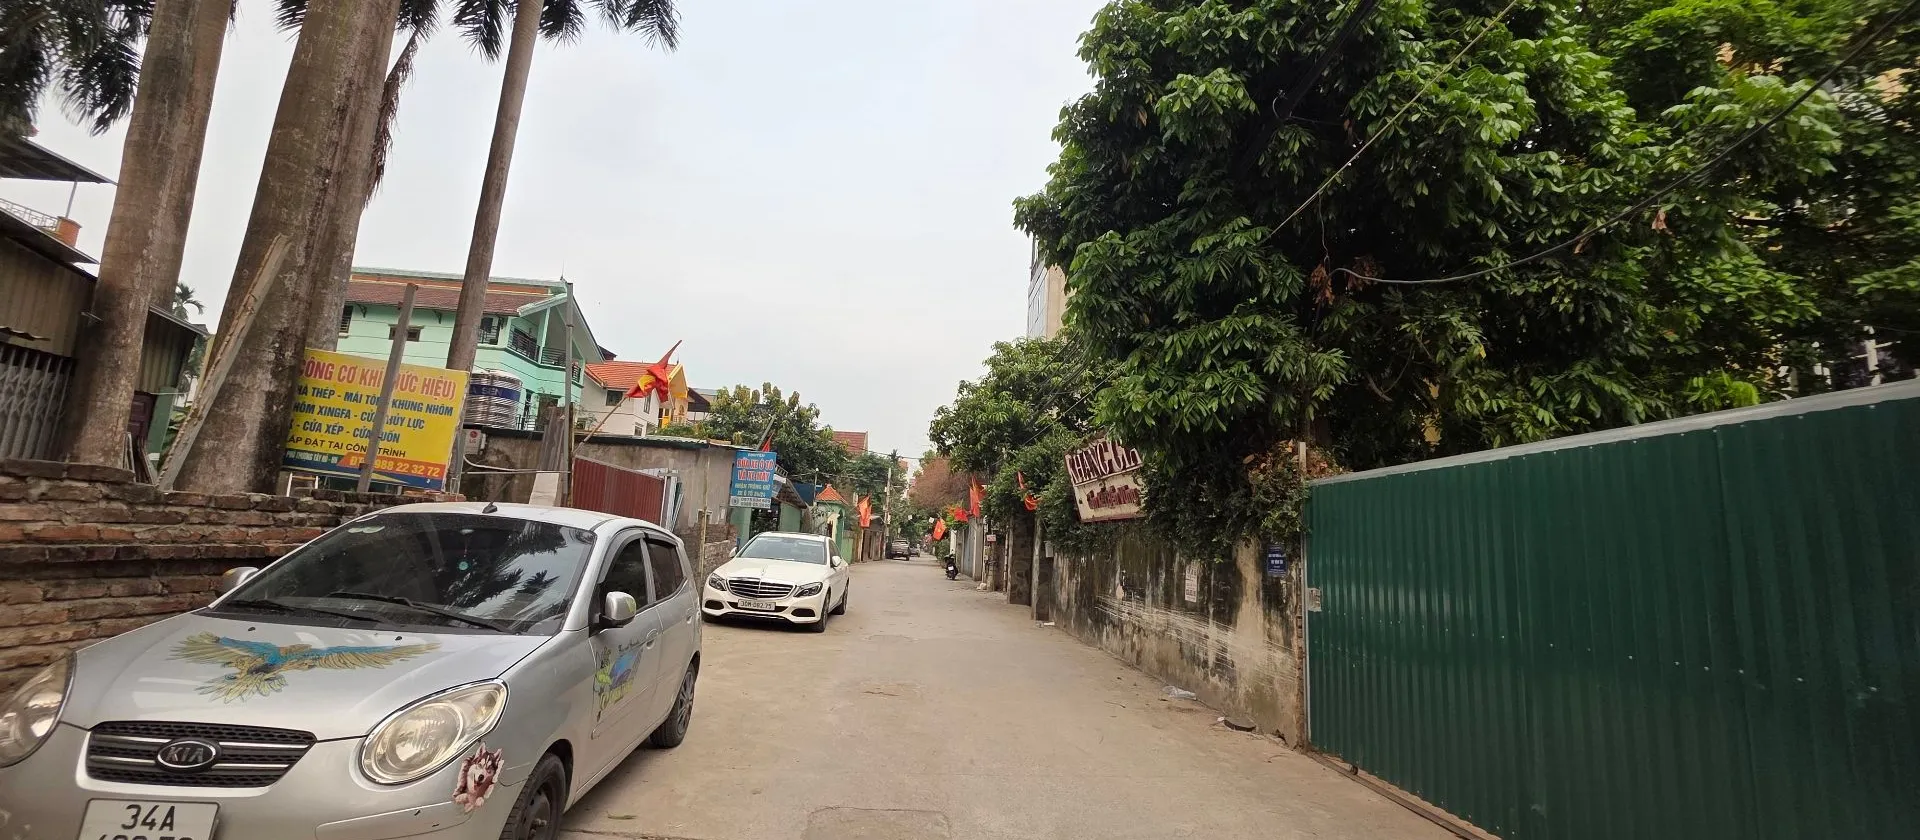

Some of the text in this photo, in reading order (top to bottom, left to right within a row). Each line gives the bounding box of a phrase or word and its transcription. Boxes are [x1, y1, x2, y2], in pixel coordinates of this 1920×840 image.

[337, 364, 358, 384] CƠ
[359, 367, 385, 388] KHÍ
[296, 384, 308, 396] HÀ
[311, 386, 336, 400] THÉP
[344, 391, 363, 403] MÁI
[391, 399, 424, 413] KHUNG
[425, 404, 454, 417] NHÔM
[292, 402, 316, 415] HÔM
[317, 405, 351, 419] XINGFA
[360, 409, 375, 422] CỬ
[407, 418, 425, 431] LỰC
[303, 419, 322, 433] CỬA
[325, 422, 344, 435] XẾP
[378, 429, 400, 443] UỐN
[327, 440, 344, 451] TẠI
[345, 443, 368, 453] CÔN
[377, 447, 406, 458] TRÌNH
[374, 460, 394, 471] 988
[395, 462, 409, 473] 22
[411, 464, 425, 475] 32
[427, 466, 440, 478] 72
[165, 746, 204, 763] KIA
[121, 804, 175, 831] 34A
